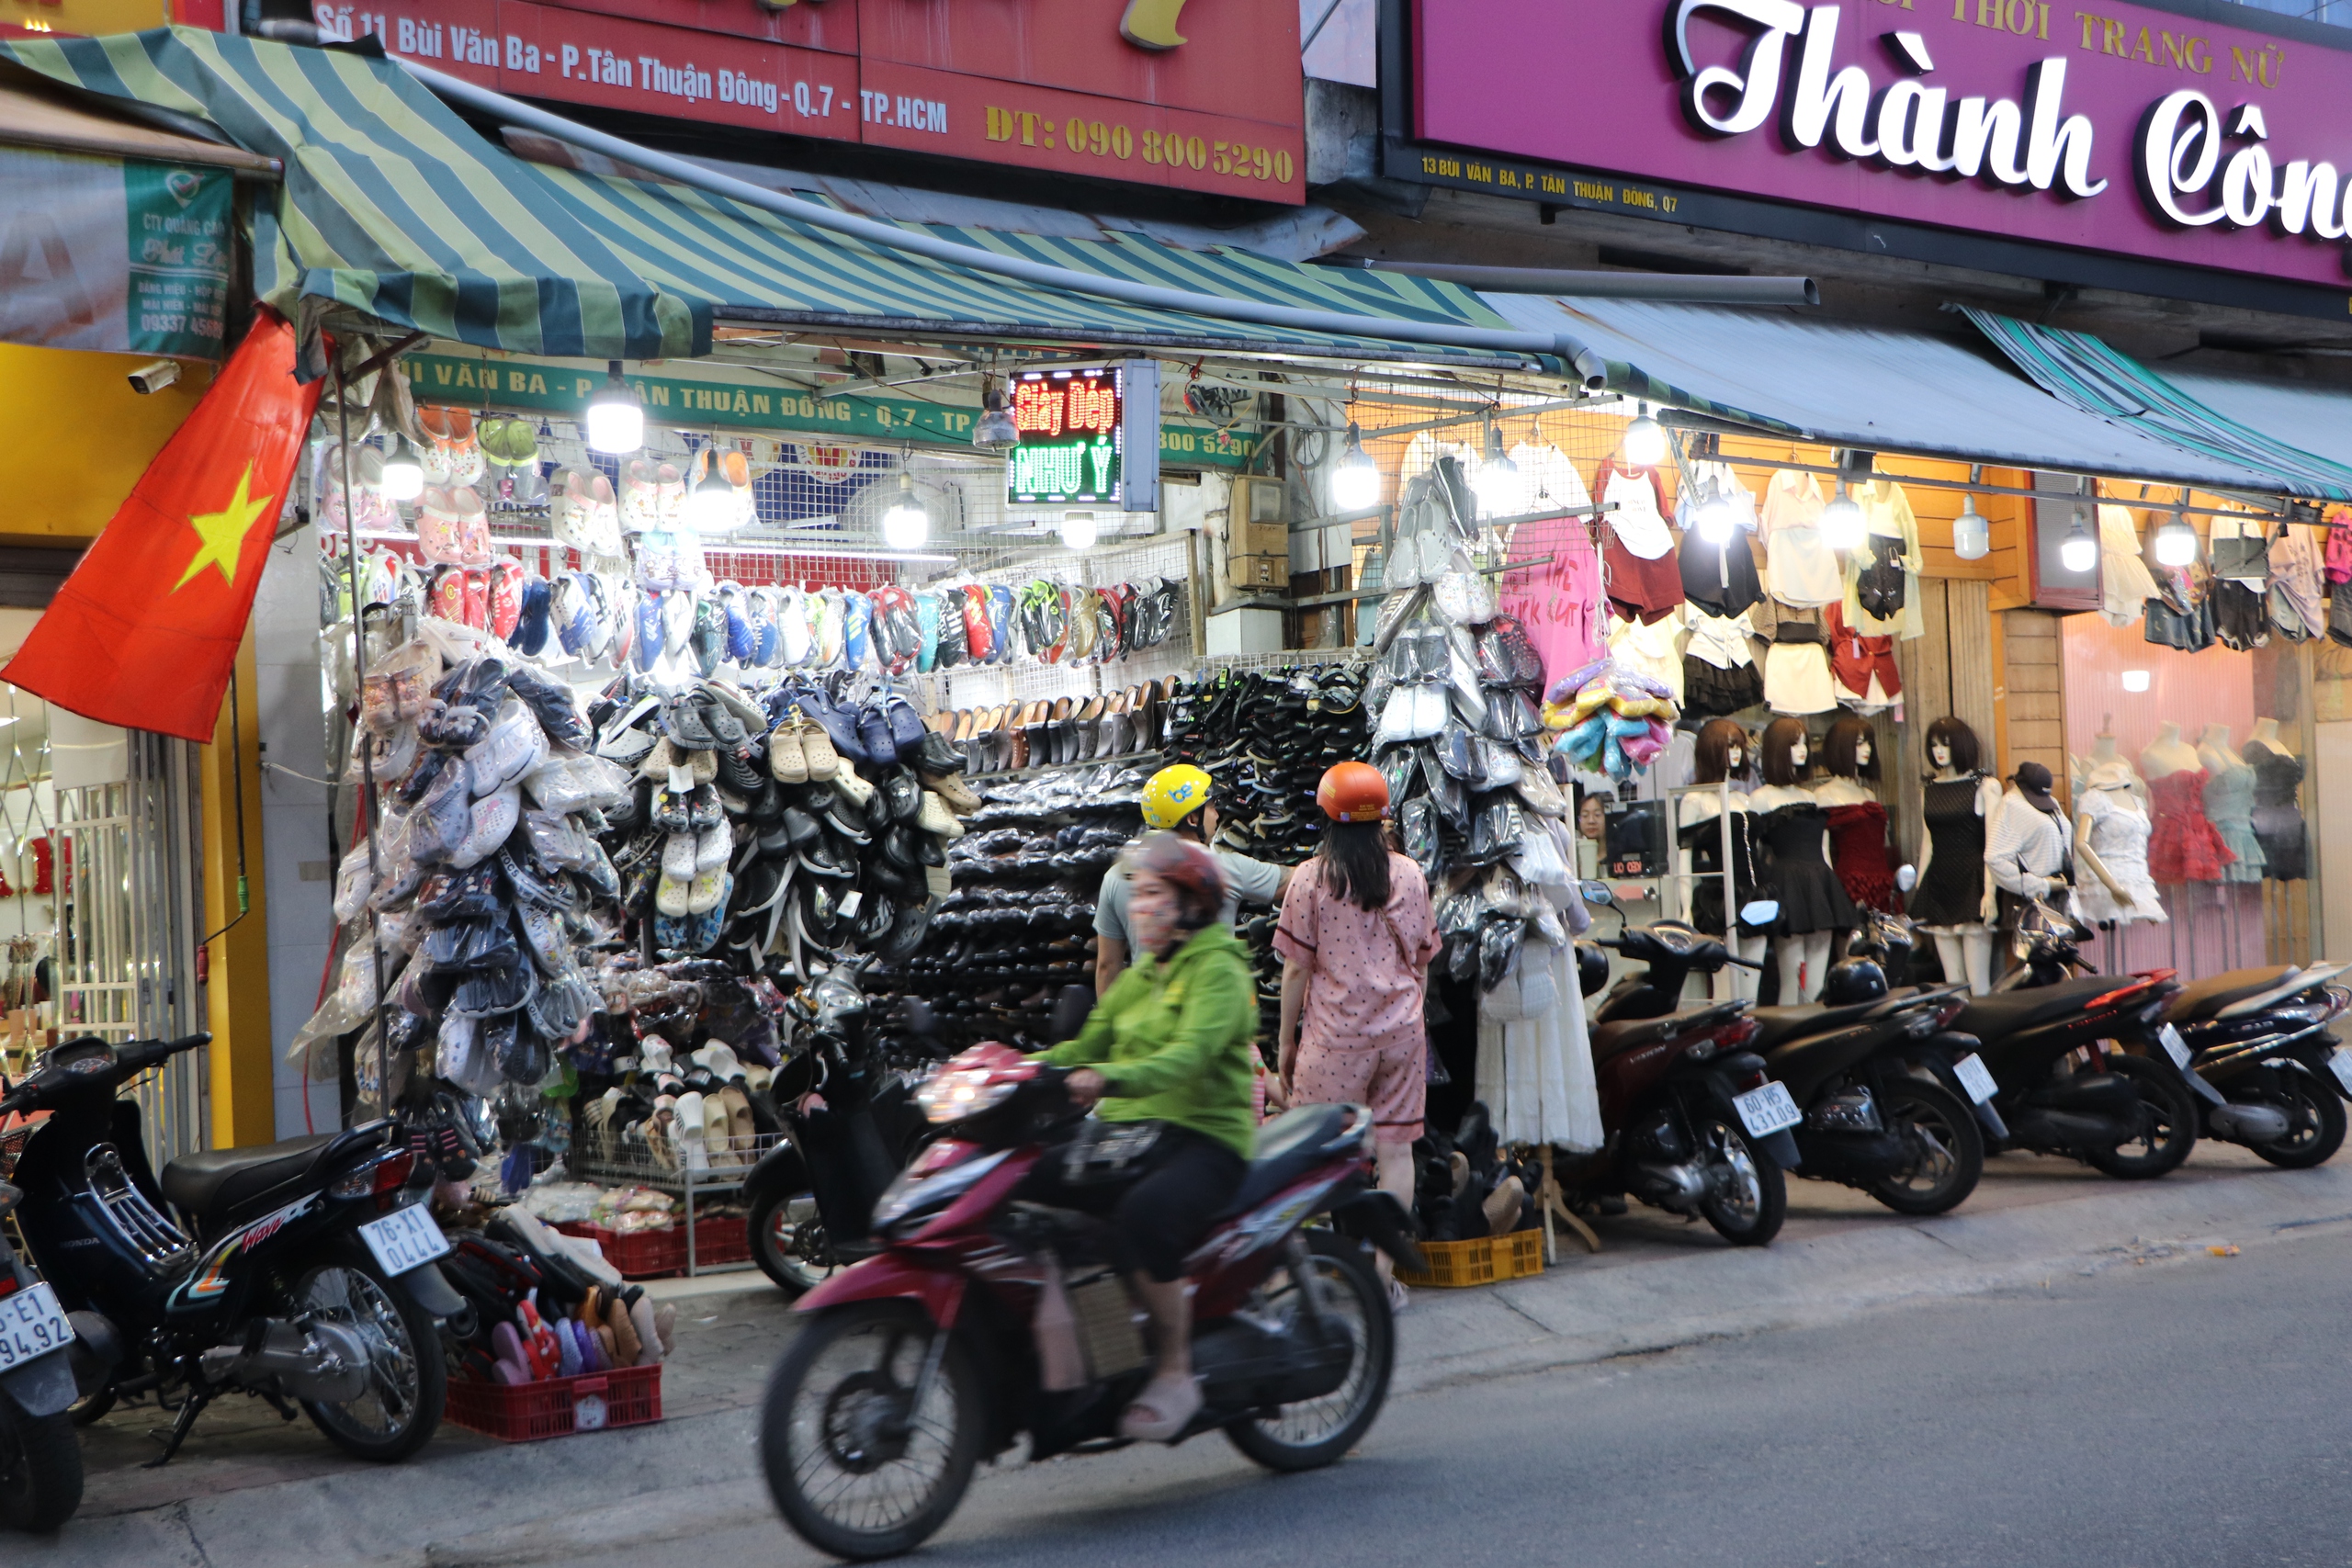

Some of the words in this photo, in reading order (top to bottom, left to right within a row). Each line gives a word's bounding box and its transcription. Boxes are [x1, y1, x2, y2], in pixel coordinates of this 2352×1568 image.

[317, 5, 355, 40] Số
[360, 13, 386, 49] 11
[399, 17, 442, 59] Bùi
[450, 26, 500, 67] Văn
[506, 36, 540, 73] Ba
[562, 44, 632, 87] P.Tân
[639, 56, 712, 103] Thuận
[795, 81, 834, 118] Q.7
[860, 90, 947, 134] TP.HCM
[2075, 11, 2213, 74] TRANG
[2230, 42, 2285, 89] NỮ
[1676, 0, 2108, 197] Thành
[2144, 90, 2352, 241] Côn
[1065, 117, 1133, 160] 090
[1141, 129, 1207, 171] 800
[1212, 140, 1294, 184] 5290
[1421, 156, 1437, 174] 13
[1439, 157, 1460, 178] BÙI
[1466, 161, 1492, 183] VĂN
[1499, 168, 1521, 189] BA,
[1541, 174, 1566, 194] TÂN
[1573, 181, 1613, 203] THUẬN
[1623, 186, 1658, 211] ĐÔNG,
[1662, 196, 1678, 213] Q7
[435, 363, 498, 389] VĂN
[509, 371, 548, 395] BA
[680, 388, 771, 417] THUẬN
[781, 395, 851, 422] ĐÔNG
[876, 405, 917, 428] Q.7
[1016, 381, 1064, 436] Giày
[1069, 379, 1114, 434] Dép
[1015, 441, 1086, 493] NHƯ
[1090, 434, 1113, 493] Ý
[1168, 784, 1193, 804] be
[59, 1236, 100, 1248] HONDA
[241, 1215, 287, 1255] Wave
[370, 1208, 424, 1246] 76-X1
[387, 1232, 441, 1269] 0444
